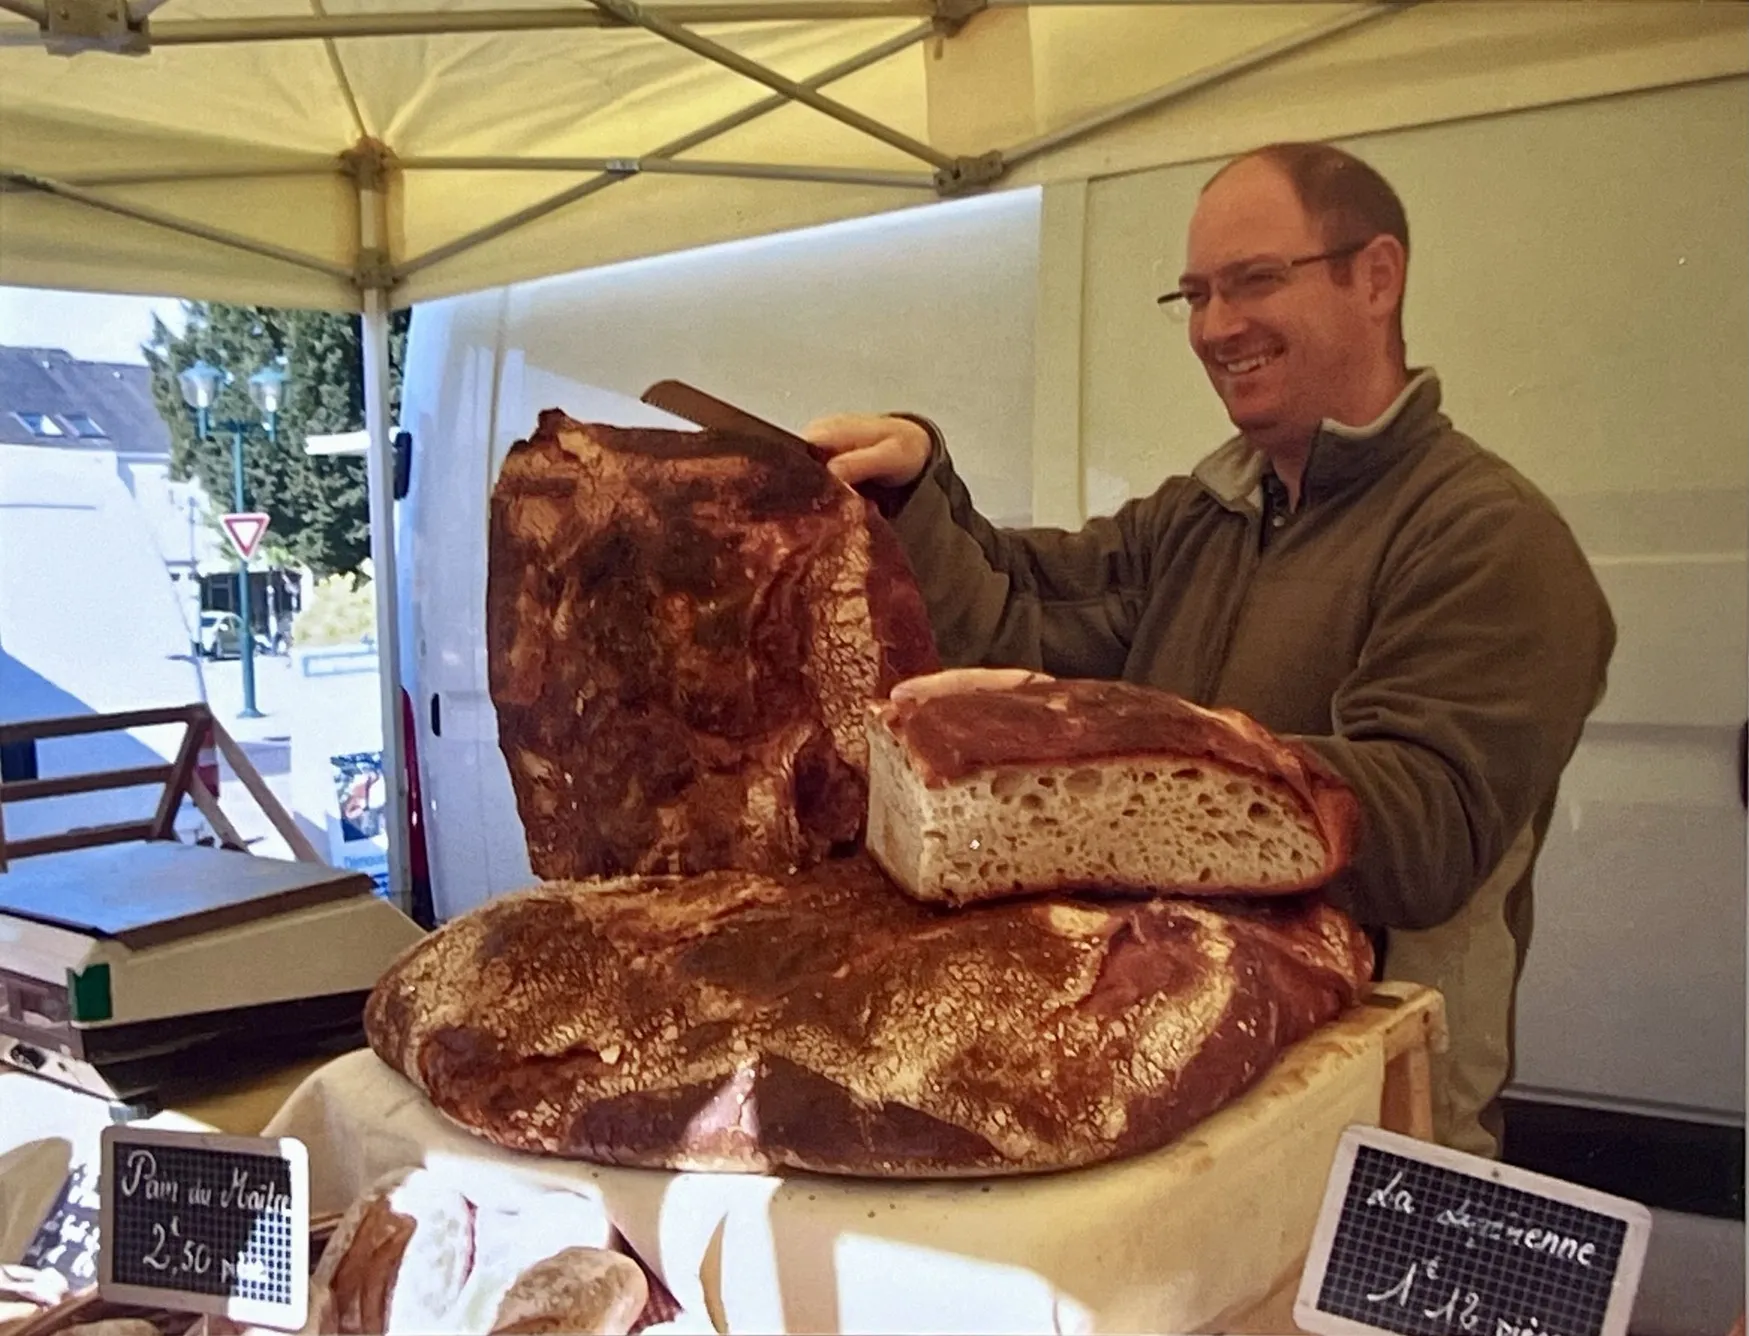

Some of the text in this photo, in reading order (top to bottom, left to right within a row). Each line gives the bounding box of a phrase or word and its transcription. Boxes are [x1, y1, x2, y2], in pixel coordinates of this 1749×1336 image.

[121, 1150, 179, 1203] Pain
[188, 1179, 212, 1207] du
[1367, 1171, 1415, 1214] La
